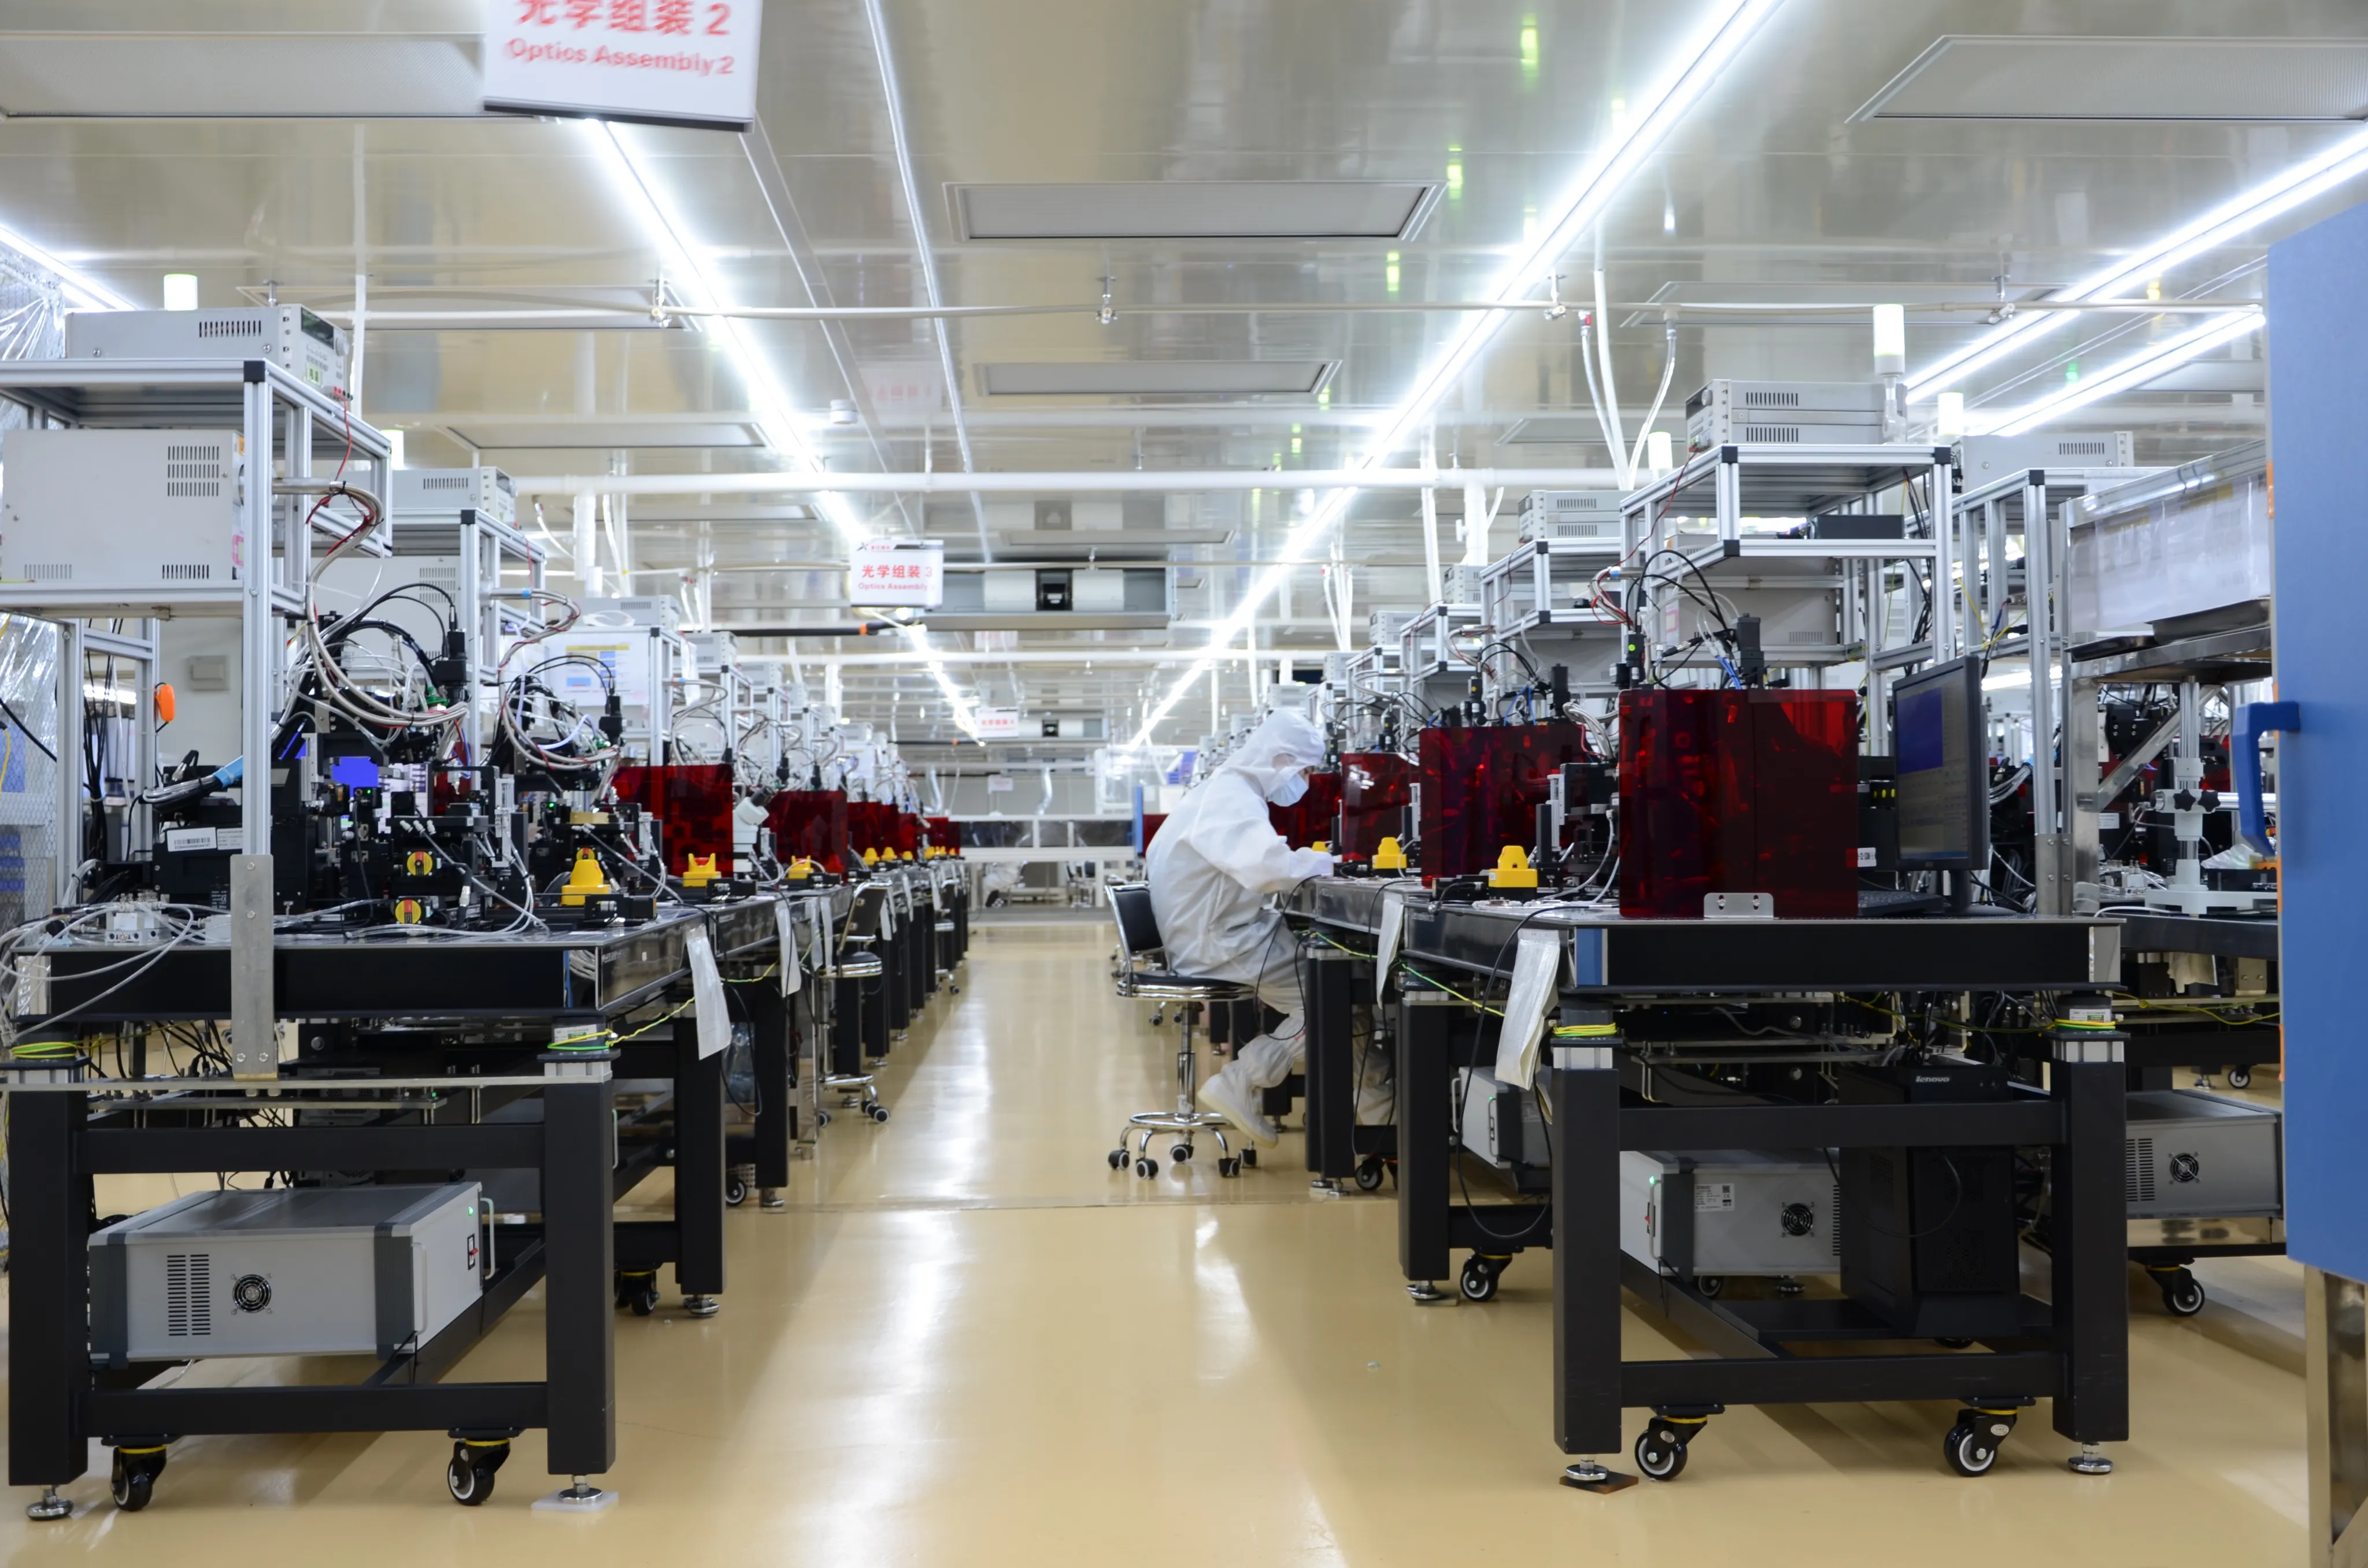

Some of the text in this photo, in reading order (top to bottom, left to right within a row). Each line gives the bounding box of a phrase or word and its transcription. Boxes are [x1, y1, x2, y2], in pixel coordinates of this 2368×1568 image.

[703, 3, 731, 35] 2
[508, 38, 735, 76] Optics Assembly 2
[861, 564, 920, 579] 光学组装
